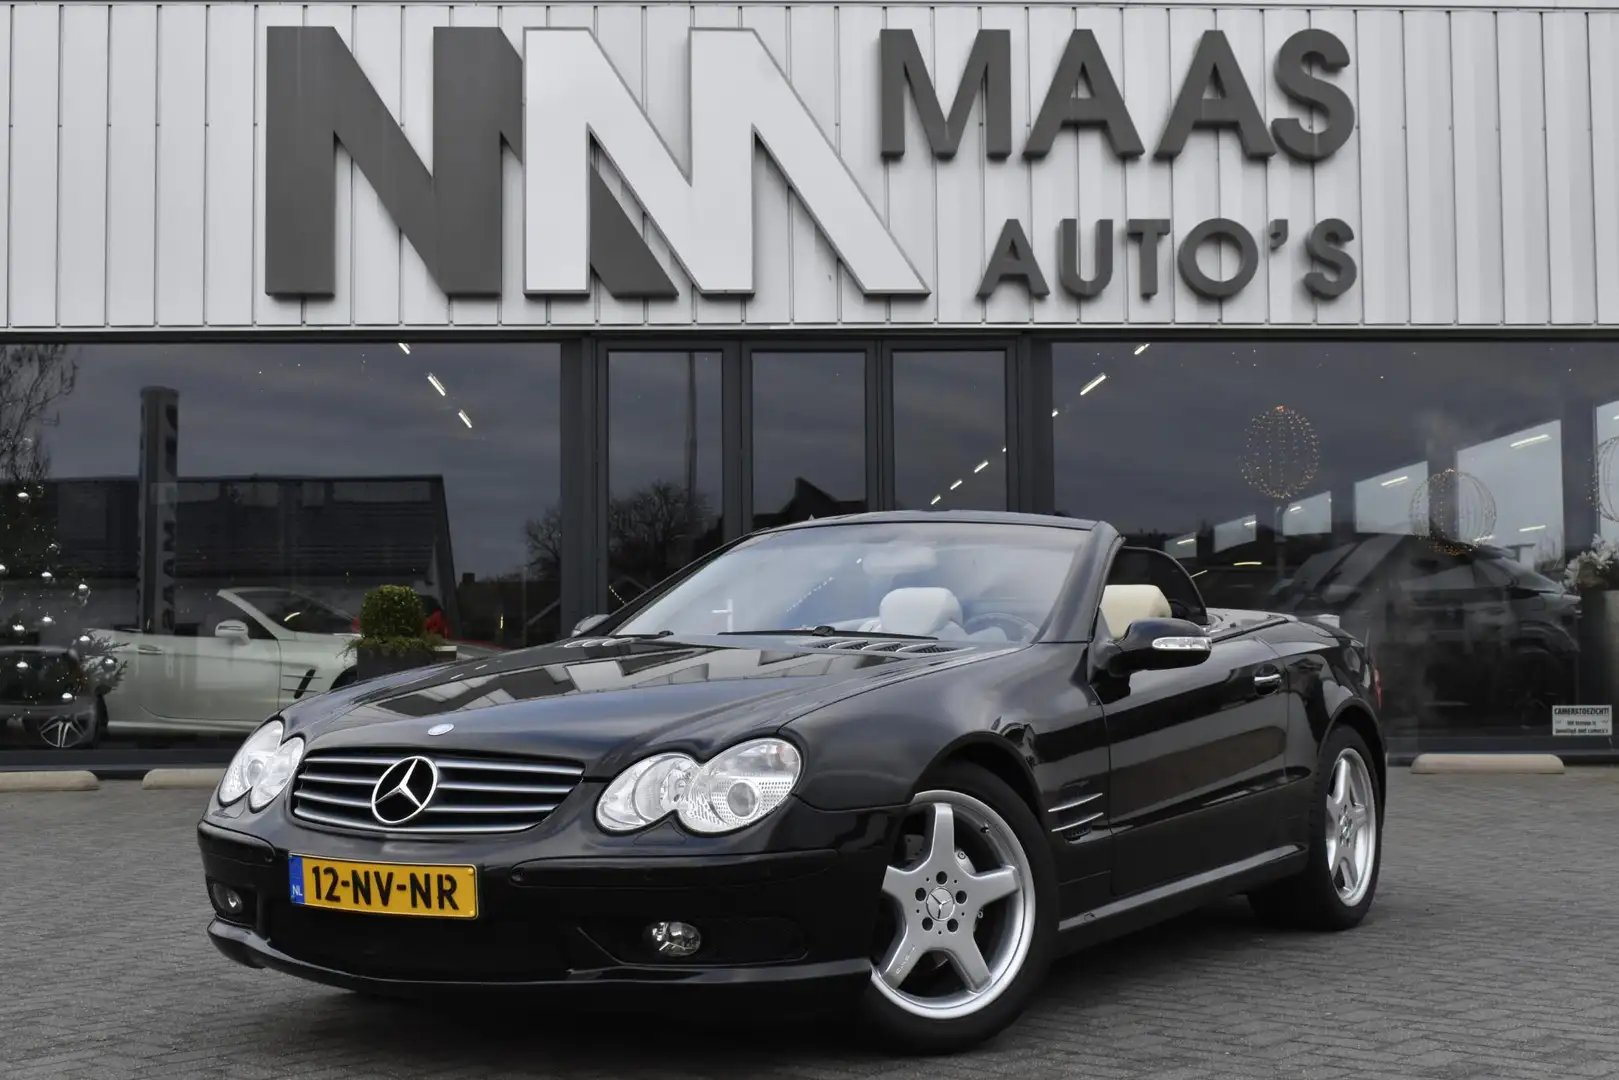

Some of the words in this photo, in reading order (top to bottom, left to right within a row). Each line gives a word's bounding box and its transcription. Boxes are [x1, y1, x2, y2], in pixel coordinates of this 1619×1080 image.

[879, 28, 1355, 161] MAAS
[976, 217, 1357, 300] AUTO'S
[292, 884, 303, 896] NL
[311, 865, 460, 910] 12-NV-NR
